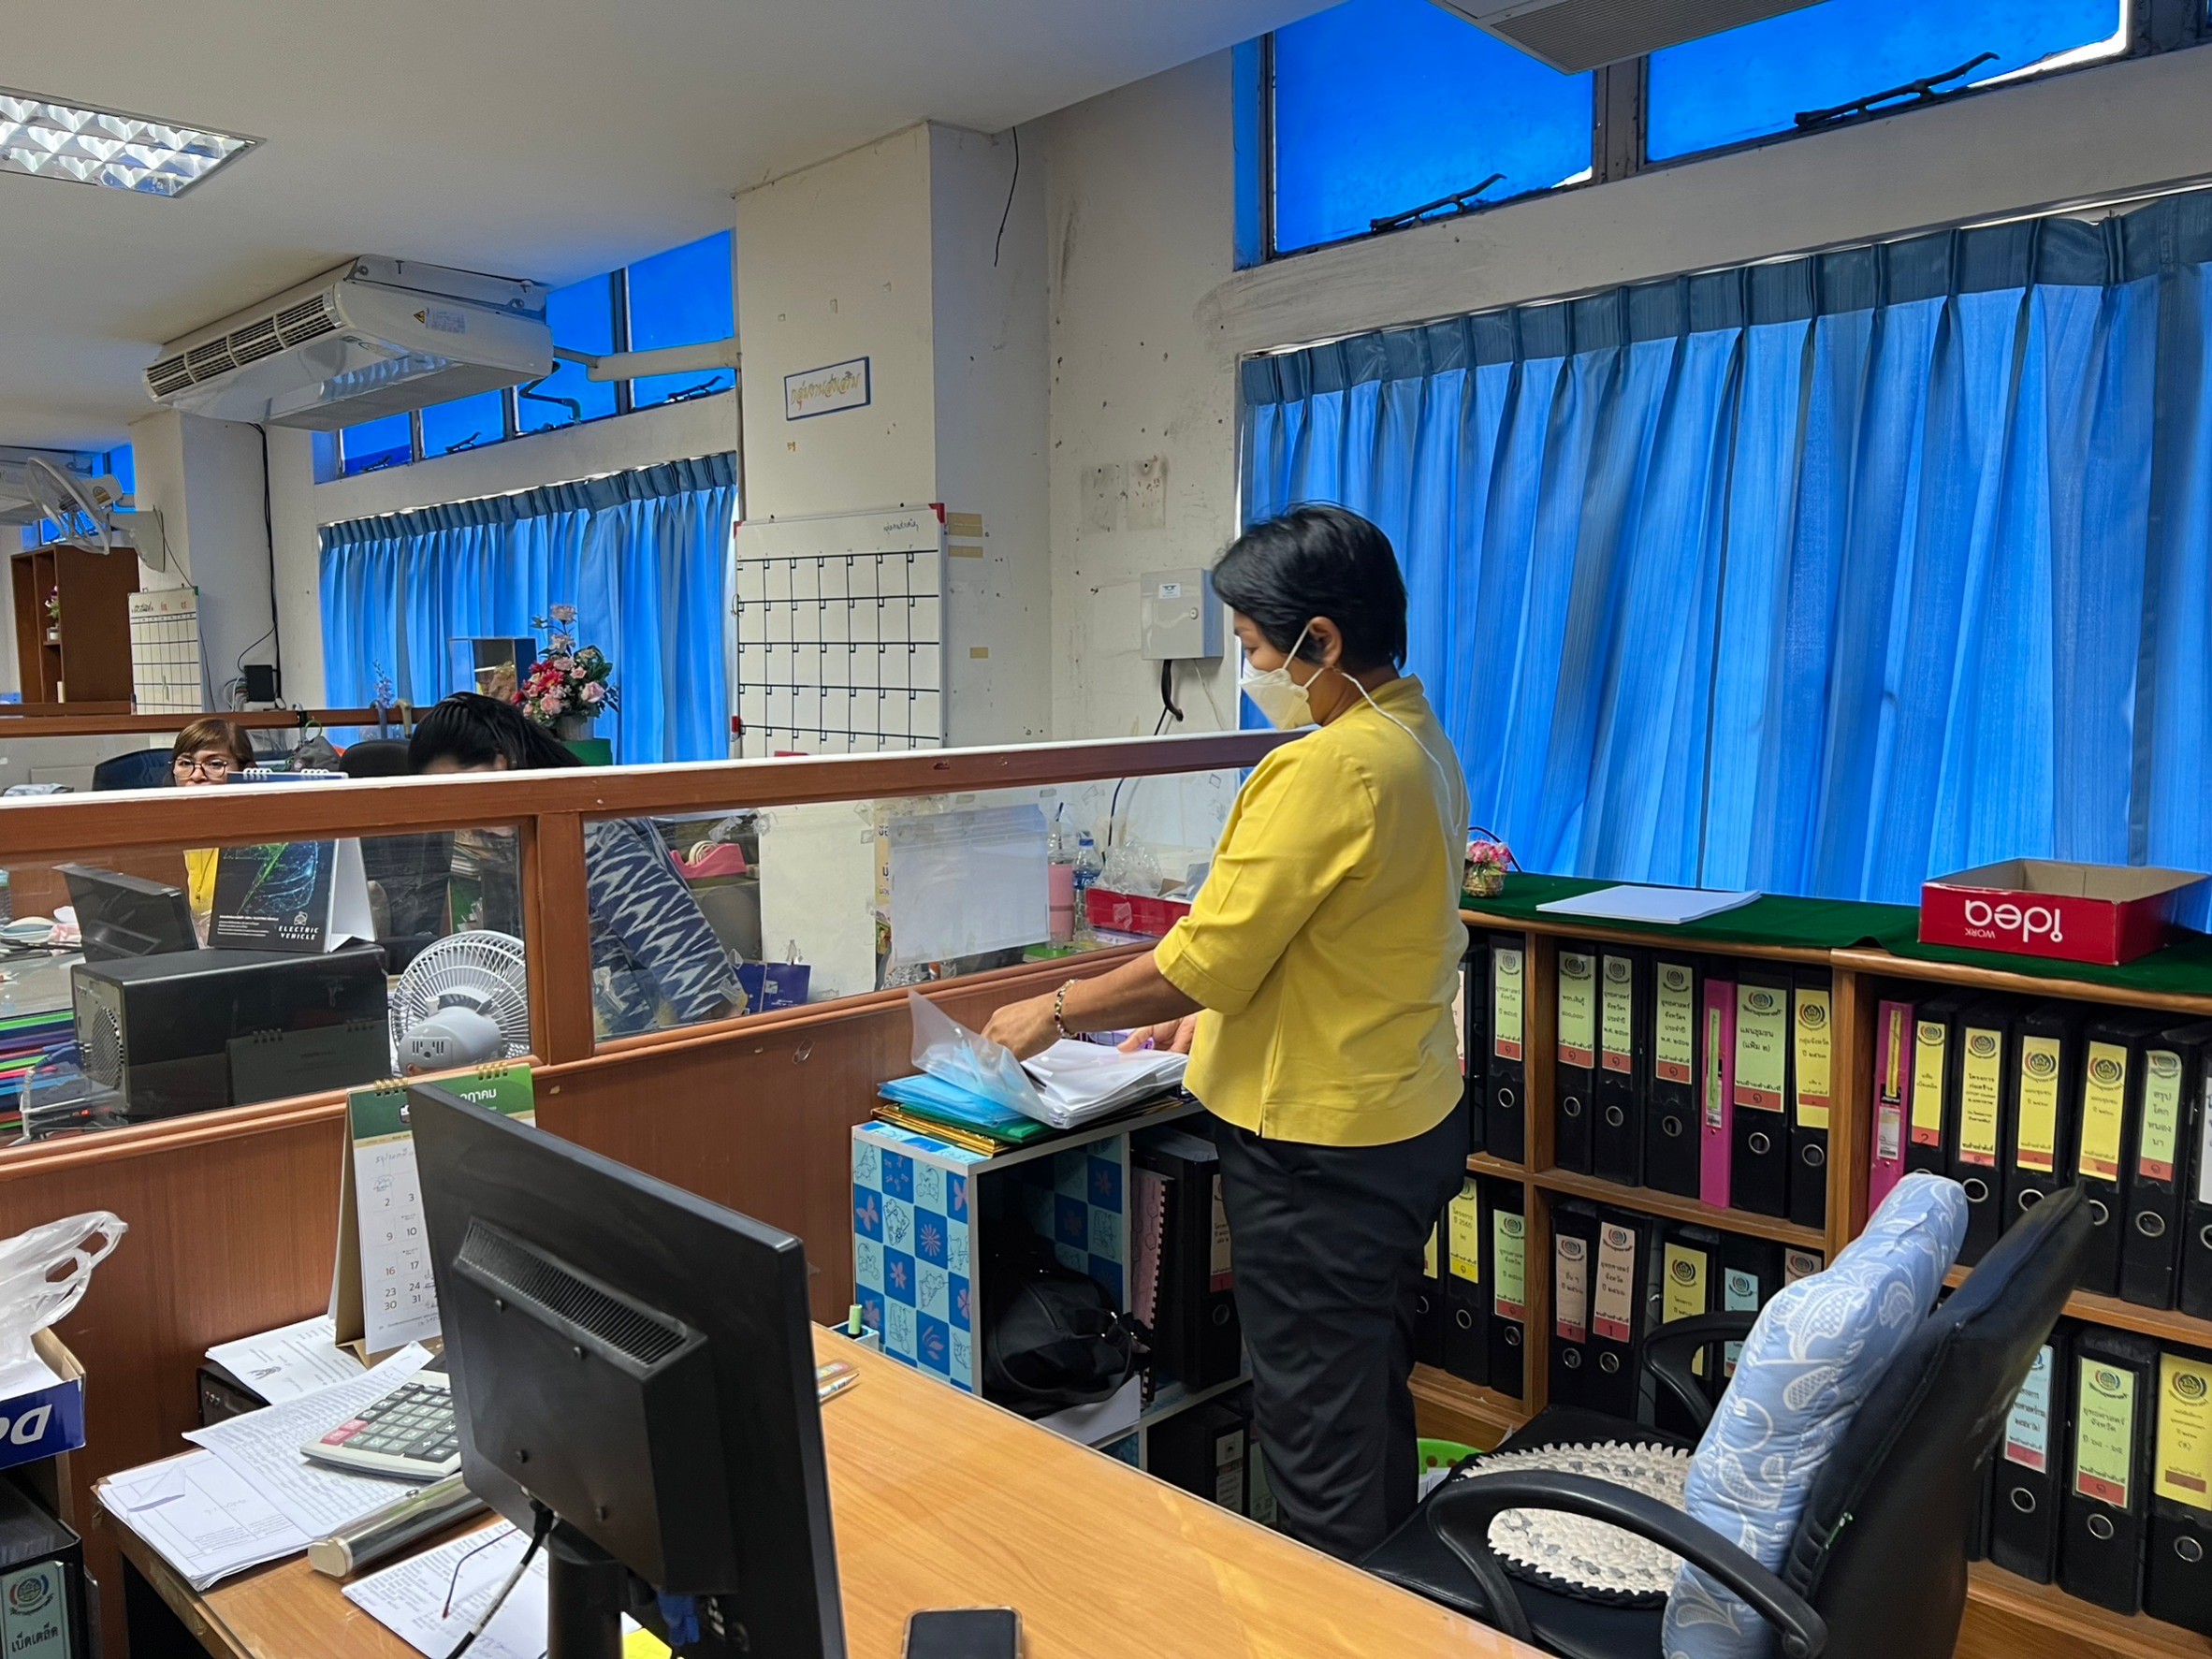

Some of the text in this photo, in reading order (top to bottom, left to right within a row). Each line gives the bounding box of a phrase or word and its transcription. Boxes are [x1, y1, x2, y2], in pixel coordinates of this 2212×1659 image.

[1965, 899, 2063, 942] idea
[278, 925, 319, 934] ELECTRIC
[1964, 927, 1996, 939] WORK
[1669, 1066, 1678, 1077] ๑
[1753, 1093, 1762, 1104] ๑
[2153, 1091, 2172, 1102] สรุป
[2153, 1103, 2169, 1116] โคก
[2147, 1121, 2172, 1132] หนอง
[2152, 1139, 2164, 1147] นา
[385, 1193, 415, 1207] 2 3
[386, 1227, 417, 1241] 9 10
[386, 1260, 419, 1275] 16 17
[386, 1282, 420, 1297] 23 24
[385, 1294, 421, 1311] 30 31
[11, 1622, 58, 1652] เบ็ดเตล็ด
